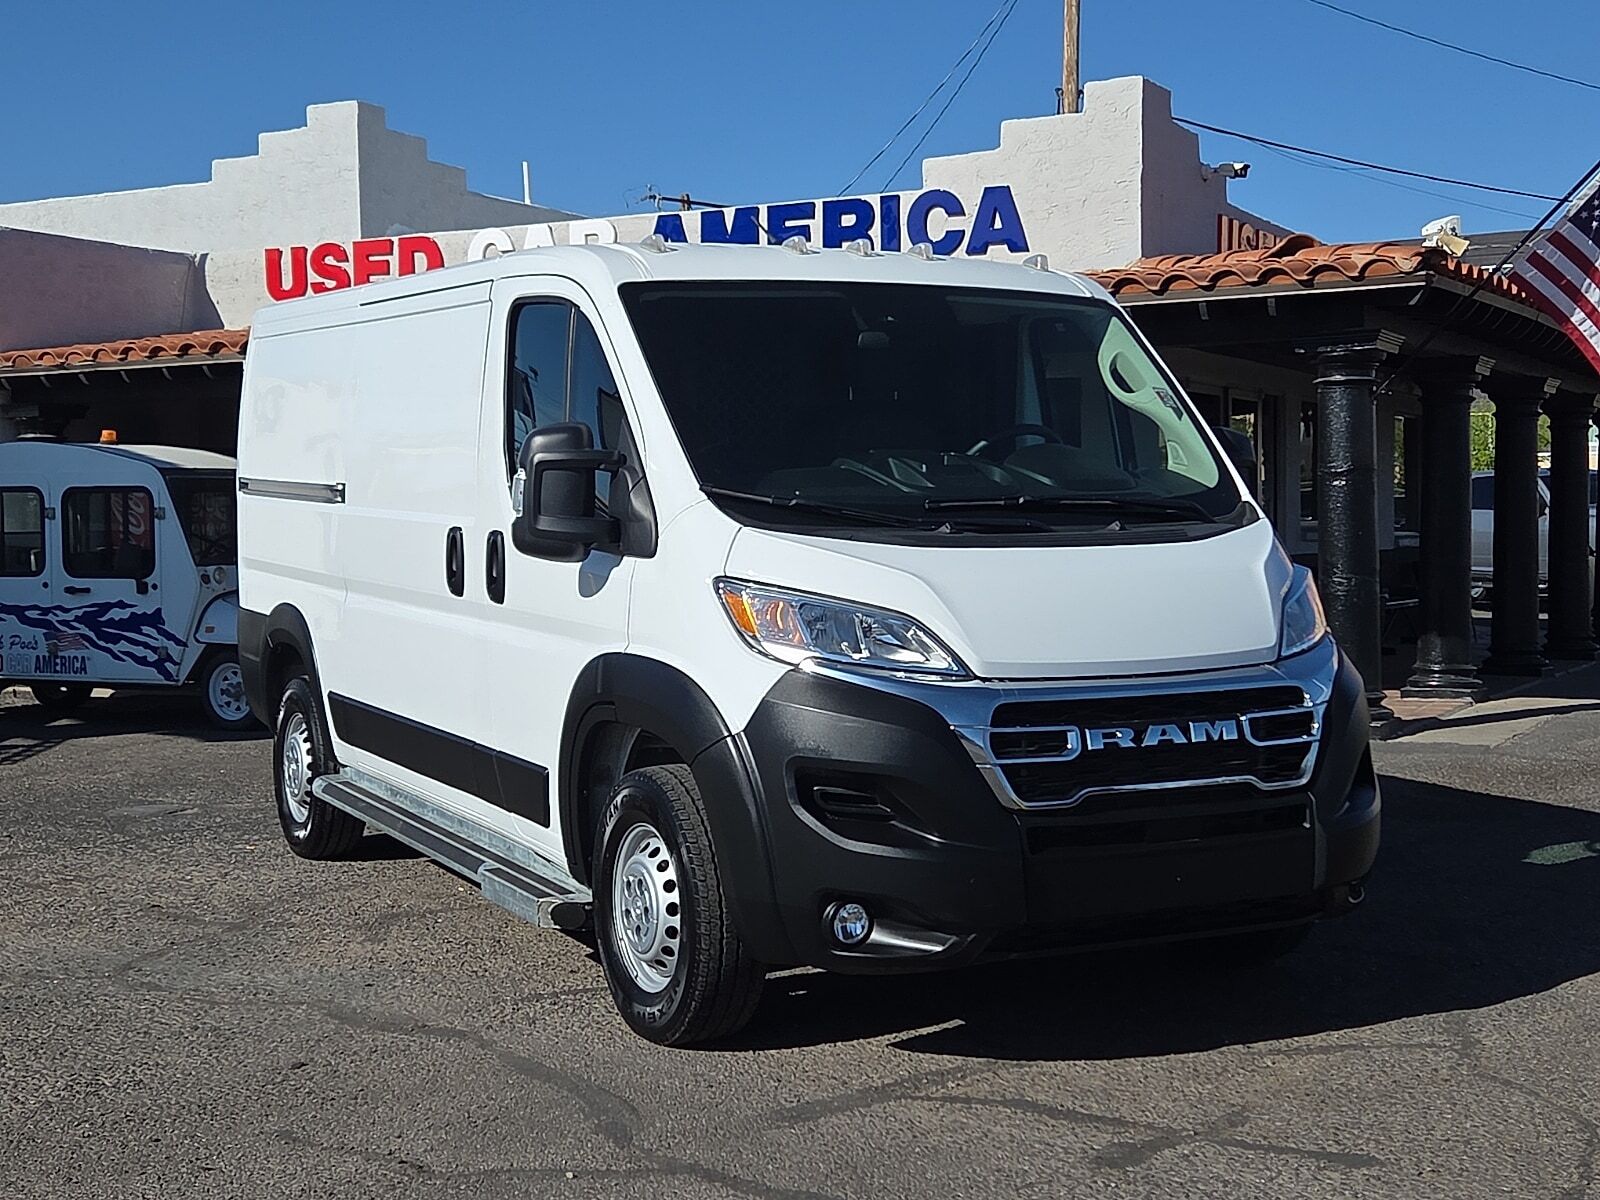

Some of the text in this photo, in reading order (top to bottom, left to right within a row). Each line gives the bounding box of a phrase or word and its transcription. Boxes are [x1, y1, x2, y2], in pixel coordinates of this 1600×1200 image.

[264, 236, 445, 302] USED
[34, 654, 88, 675] AMERICA
[1085, 719, 1239, 750] RAM
